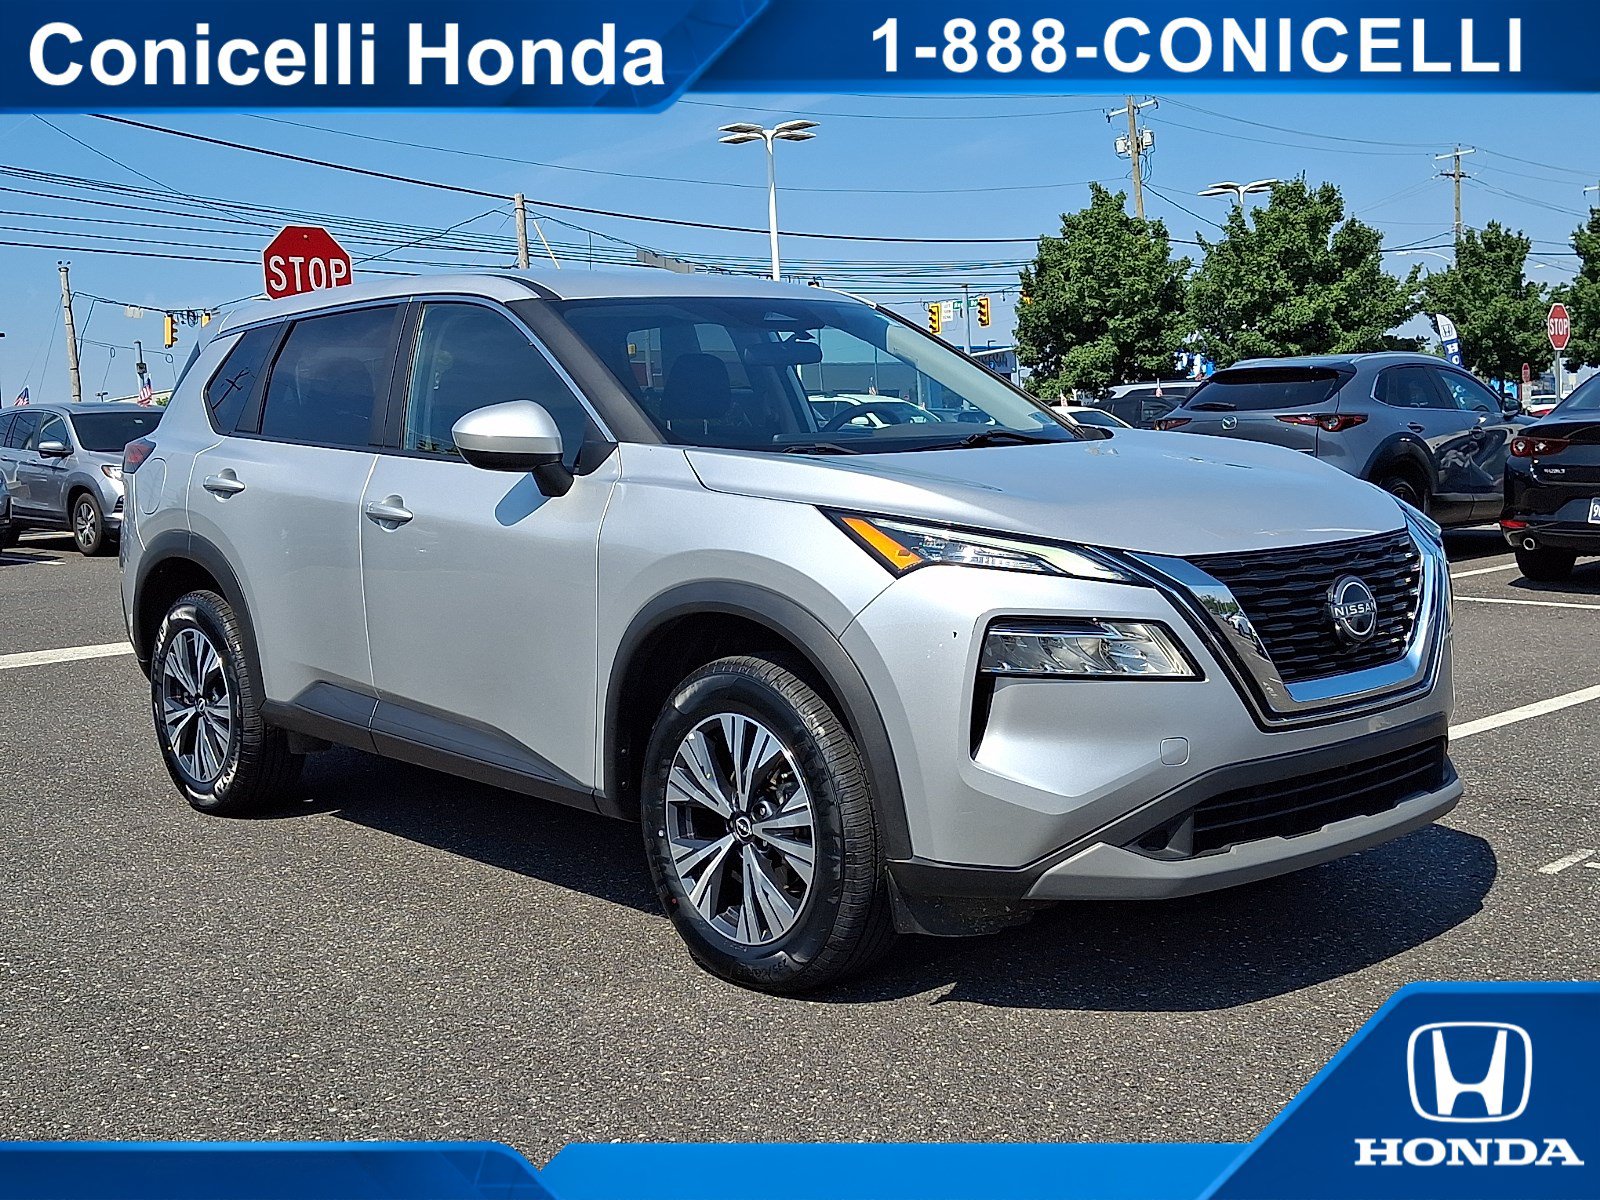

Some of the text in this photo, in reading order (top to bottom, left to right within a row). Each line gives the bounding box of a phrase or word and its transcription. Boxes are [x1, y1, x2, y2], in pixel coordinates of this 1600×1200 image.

[269, 255, 347, 292] STOP
[1549, 318, 1568, 336] STOP
[1333, 602, 1376, 618] NISSAN
